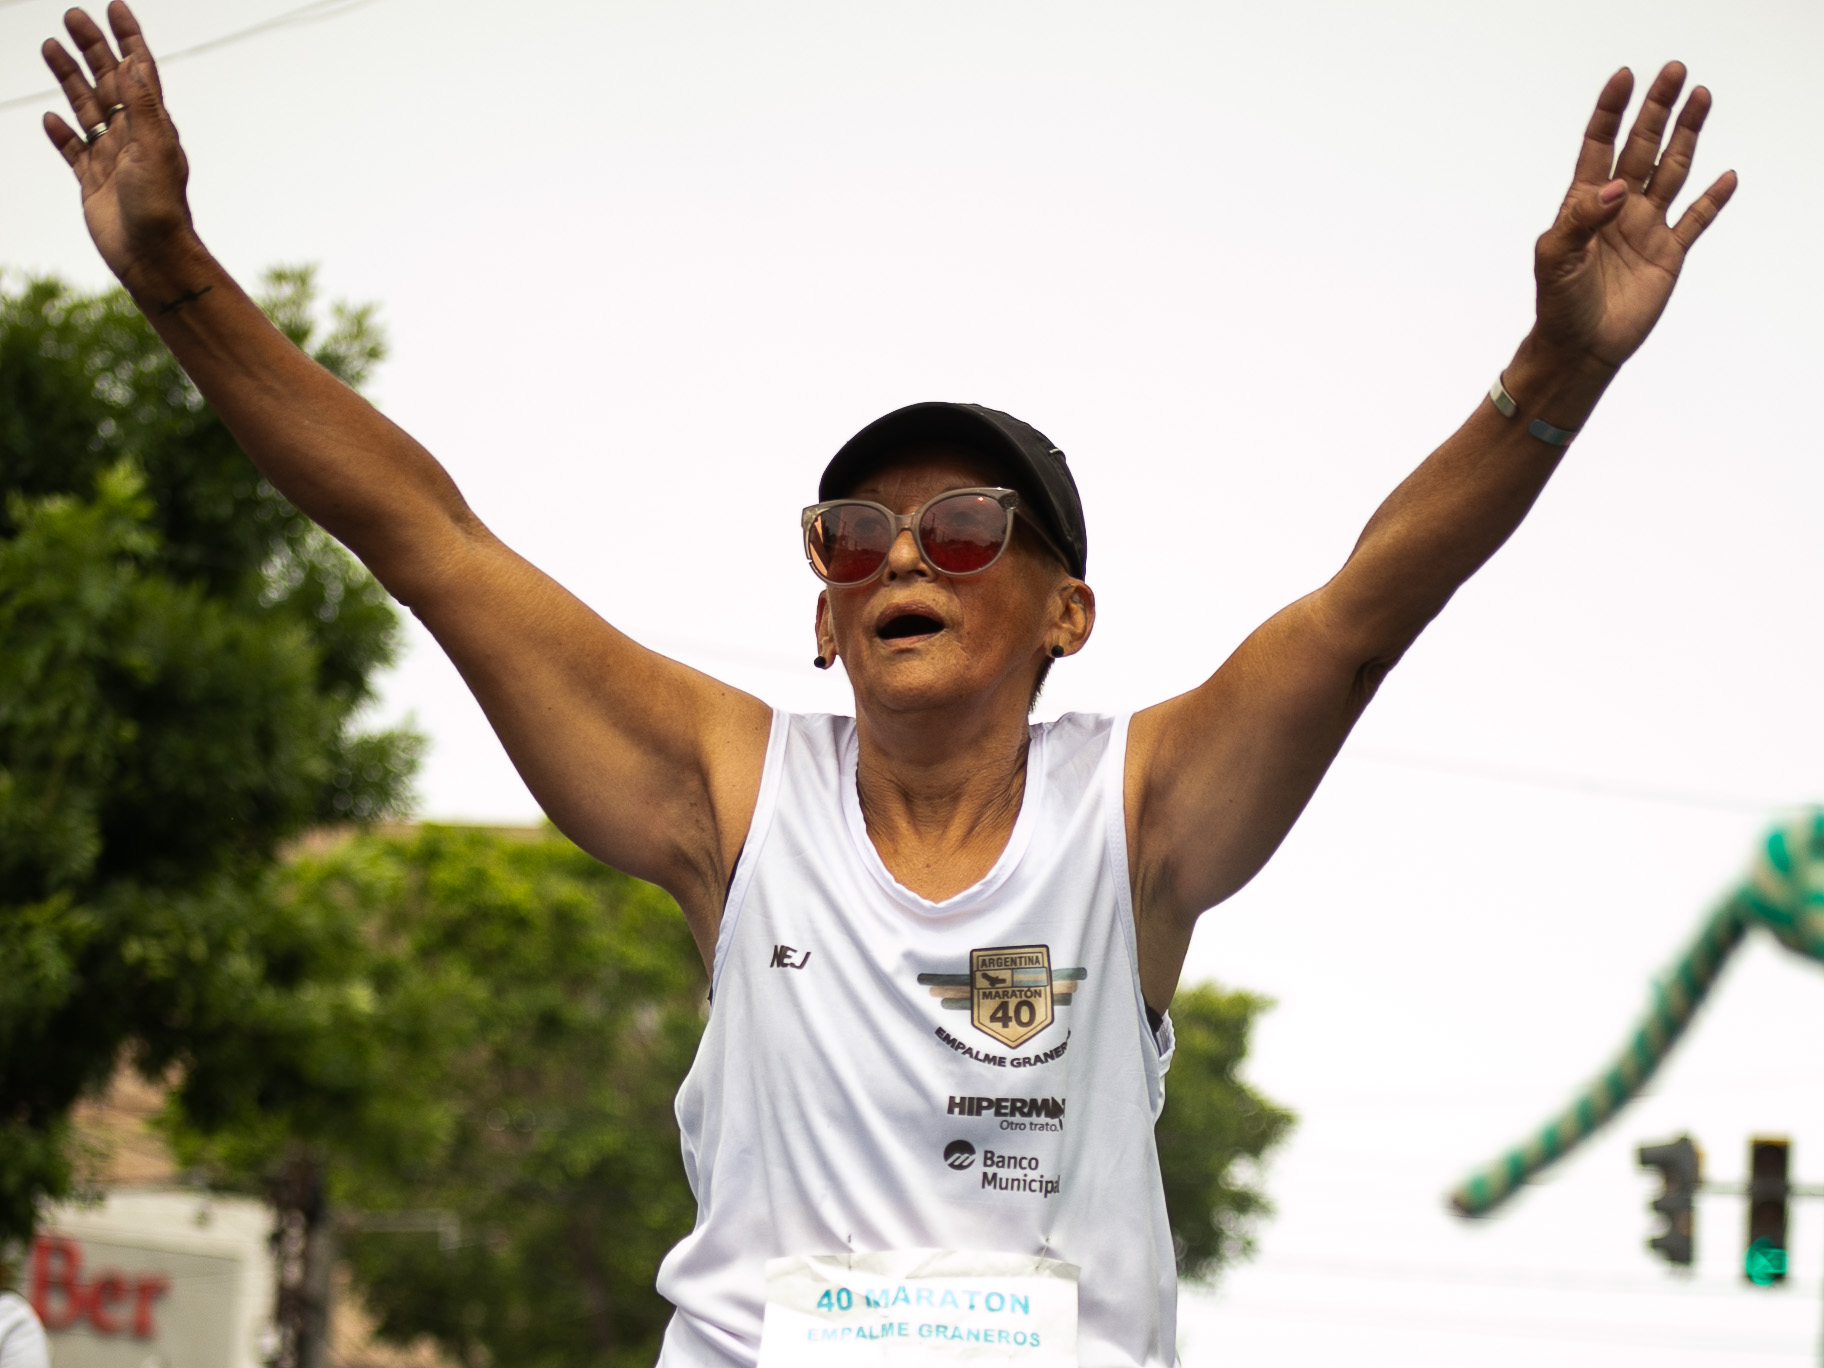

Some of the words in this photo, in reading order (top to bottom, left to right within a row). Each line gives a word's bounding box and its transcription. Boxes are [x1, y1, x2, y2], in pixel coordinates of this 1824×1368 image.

[769, 944, 812, 970] NEJ
[980, 955, 1041, 969] ARGENTINA
[981, 986, 1042, 1001] MARATÓN
[989, 1000, 1037, 1029] 40
[934, 1026, 1007, 1068] EMPALME
[1010, 1027, 1071, 1069] GRANER
[1000, 1119, 1026, 1131] Otro
[983, 1149, 1039, 1171] Banco
[816, 1287, 853, 1312] 40
[865, 1285, 1030, 1315] MARATON
[806, 1322, 910, 1342] EMPALME
[918, 1323, 1041, 1347] GRANEROS
